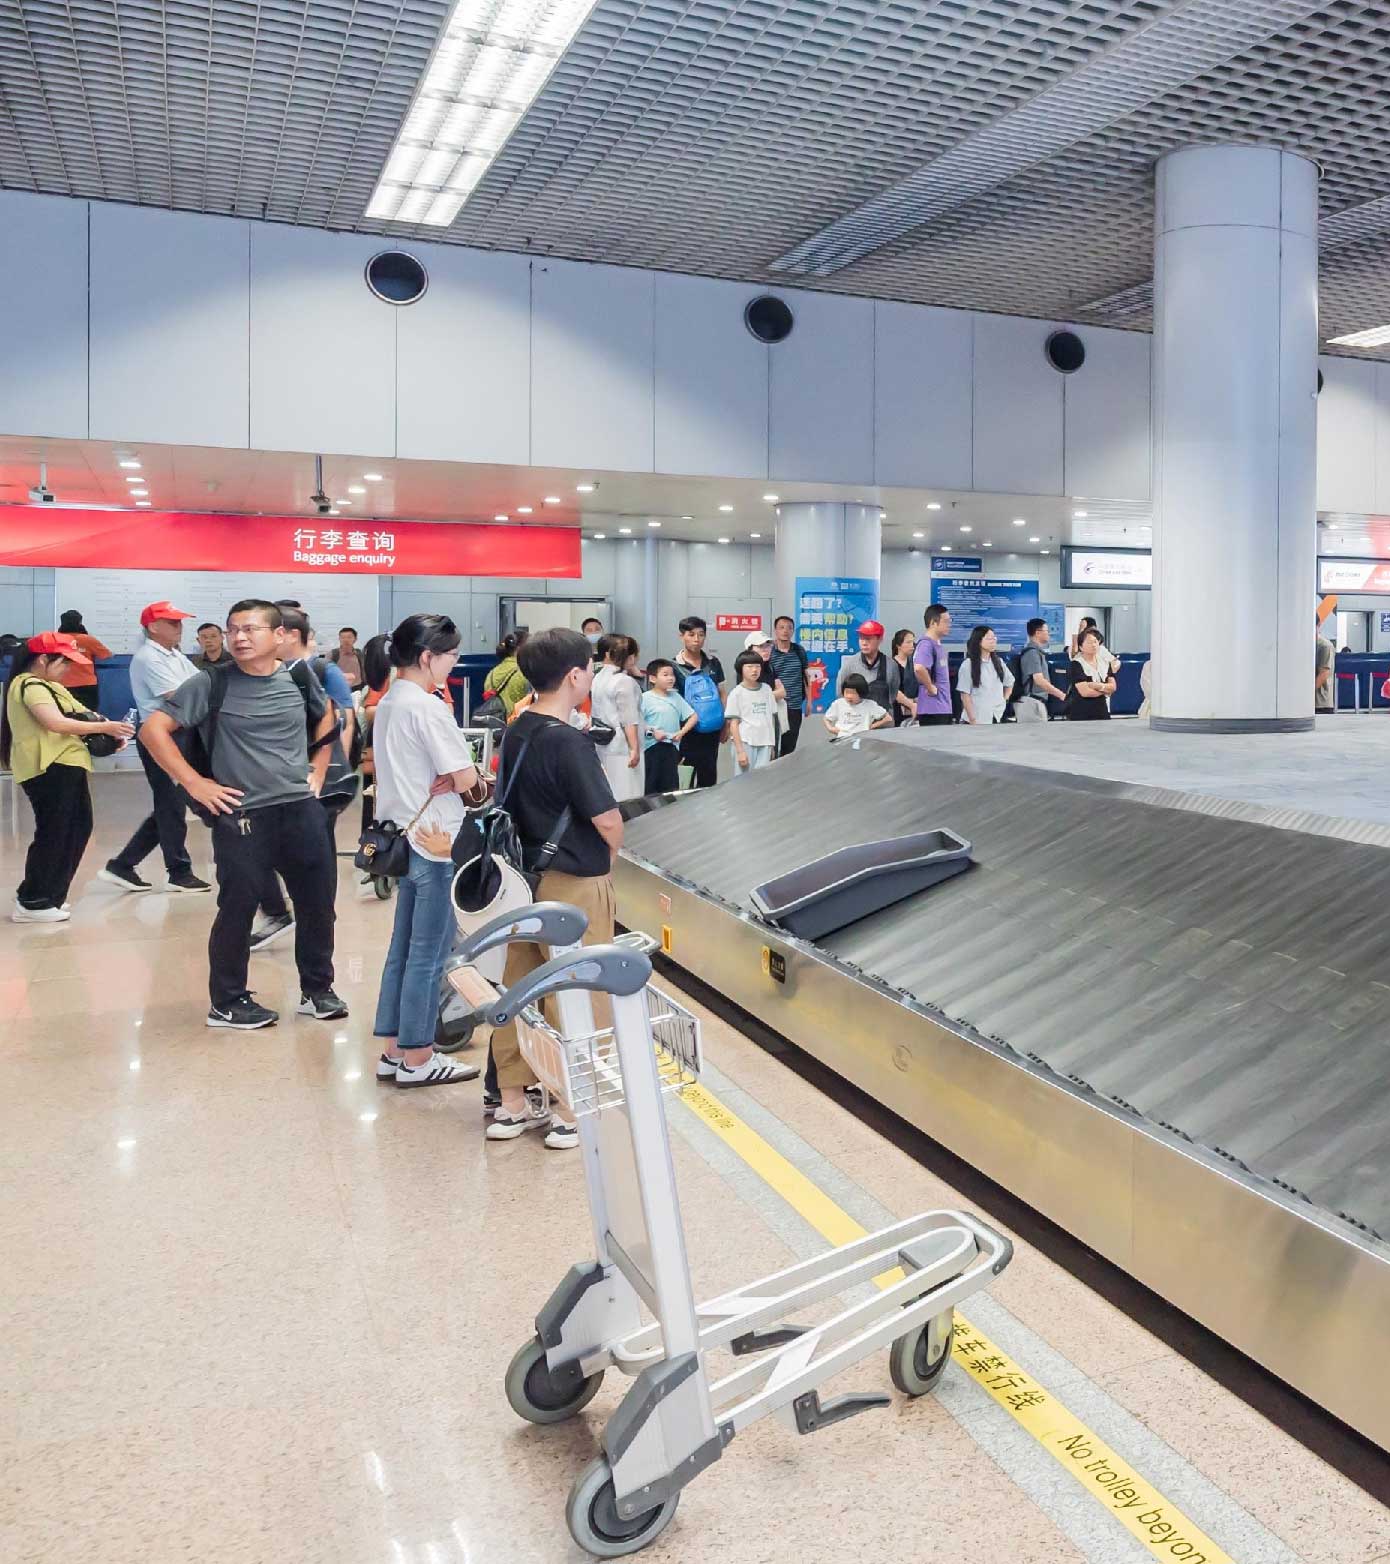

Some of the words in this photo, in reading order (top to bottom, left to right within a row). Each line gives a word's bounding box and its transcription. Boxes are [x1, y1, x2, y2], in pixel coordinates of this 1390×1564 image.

[293, 528, 395, 551] 行李查询
[293, 550, 346, 566] Baggage
[349, 553, 396, 568] enquiry
[1057, 1434, 1092, 1459] No
[1083, 1458, 1148, 1509] trolley
